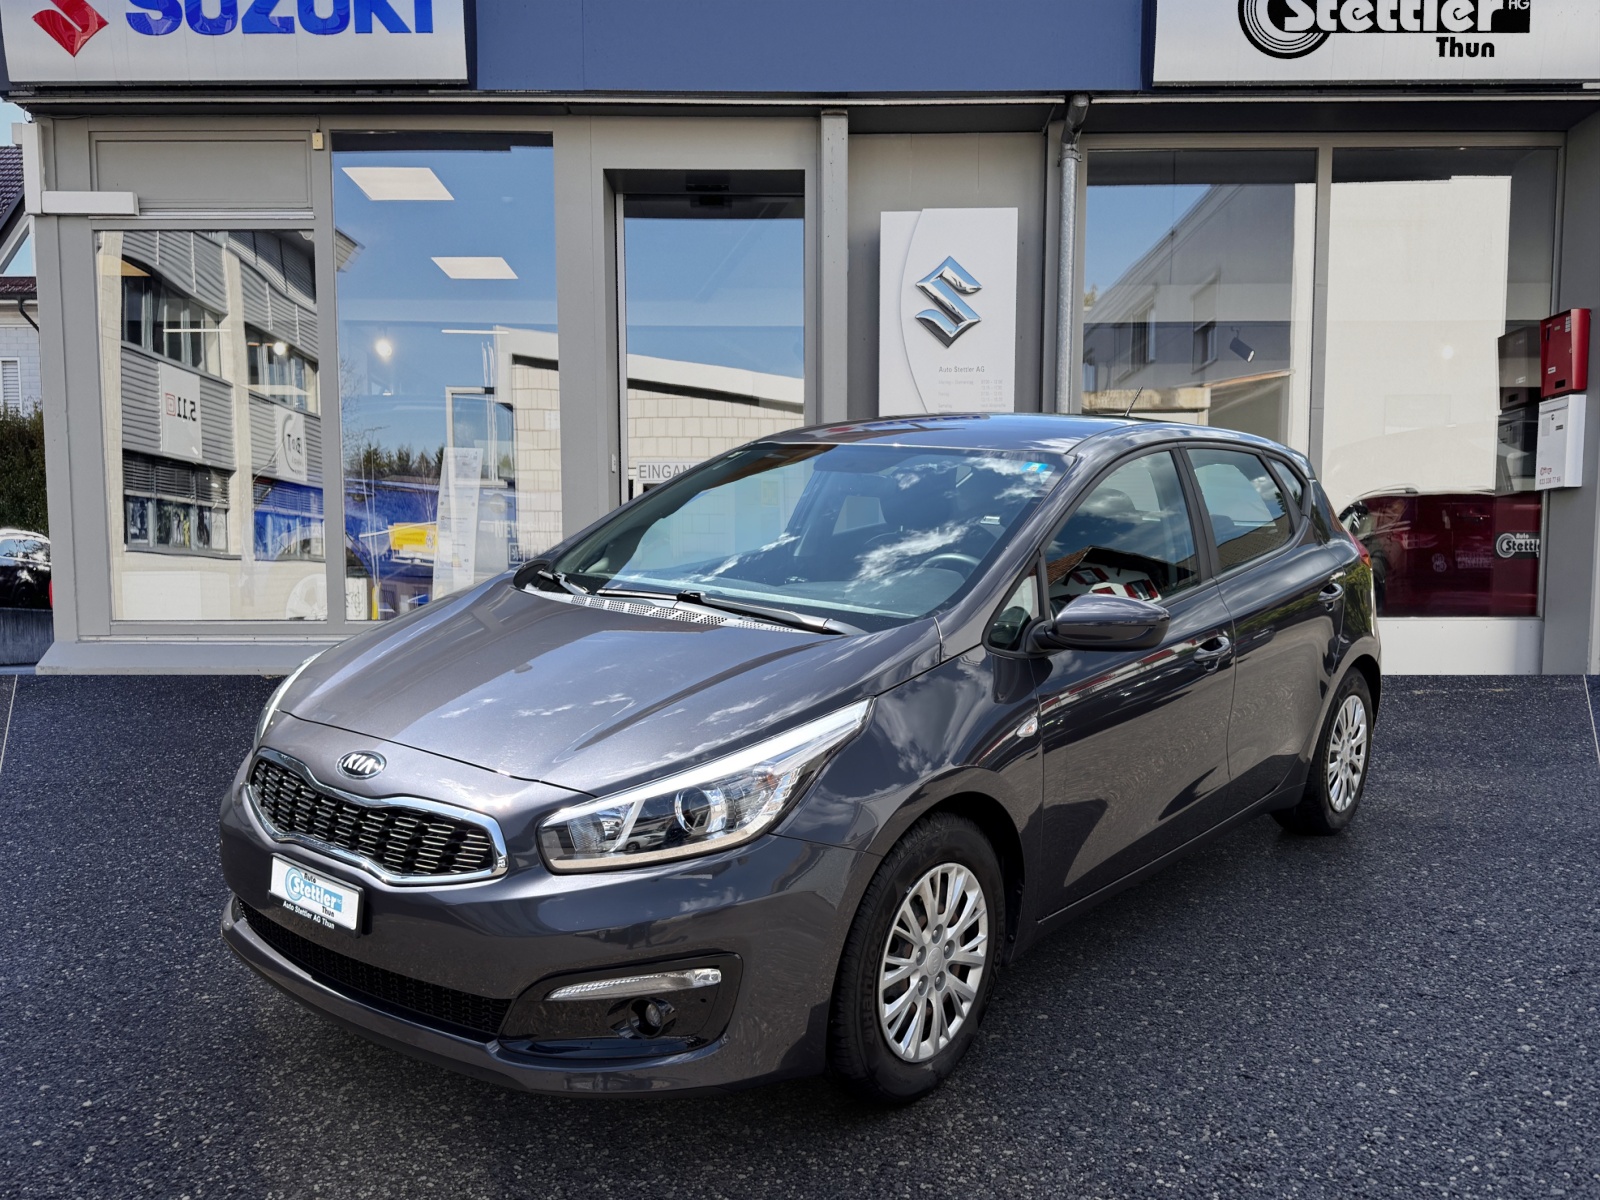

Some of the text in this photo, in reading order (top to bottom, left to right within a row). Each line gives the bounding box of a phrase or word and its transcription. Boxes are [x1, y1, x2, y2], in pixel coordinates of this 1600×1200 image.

[126, 0, 434, 36] SUZUKI
[1284, 0, 1504, 32] Stettler
[1436, 36, 1495, 57] Thun
[343, 753, 376, 774] KIA
[304, 873, 316, 884] Auto
[293, 877, 337, 909] Stettler
[283, 900, 335, 930] Auto Stettler AG Thun
[322, 906, 335, 918] Thun
